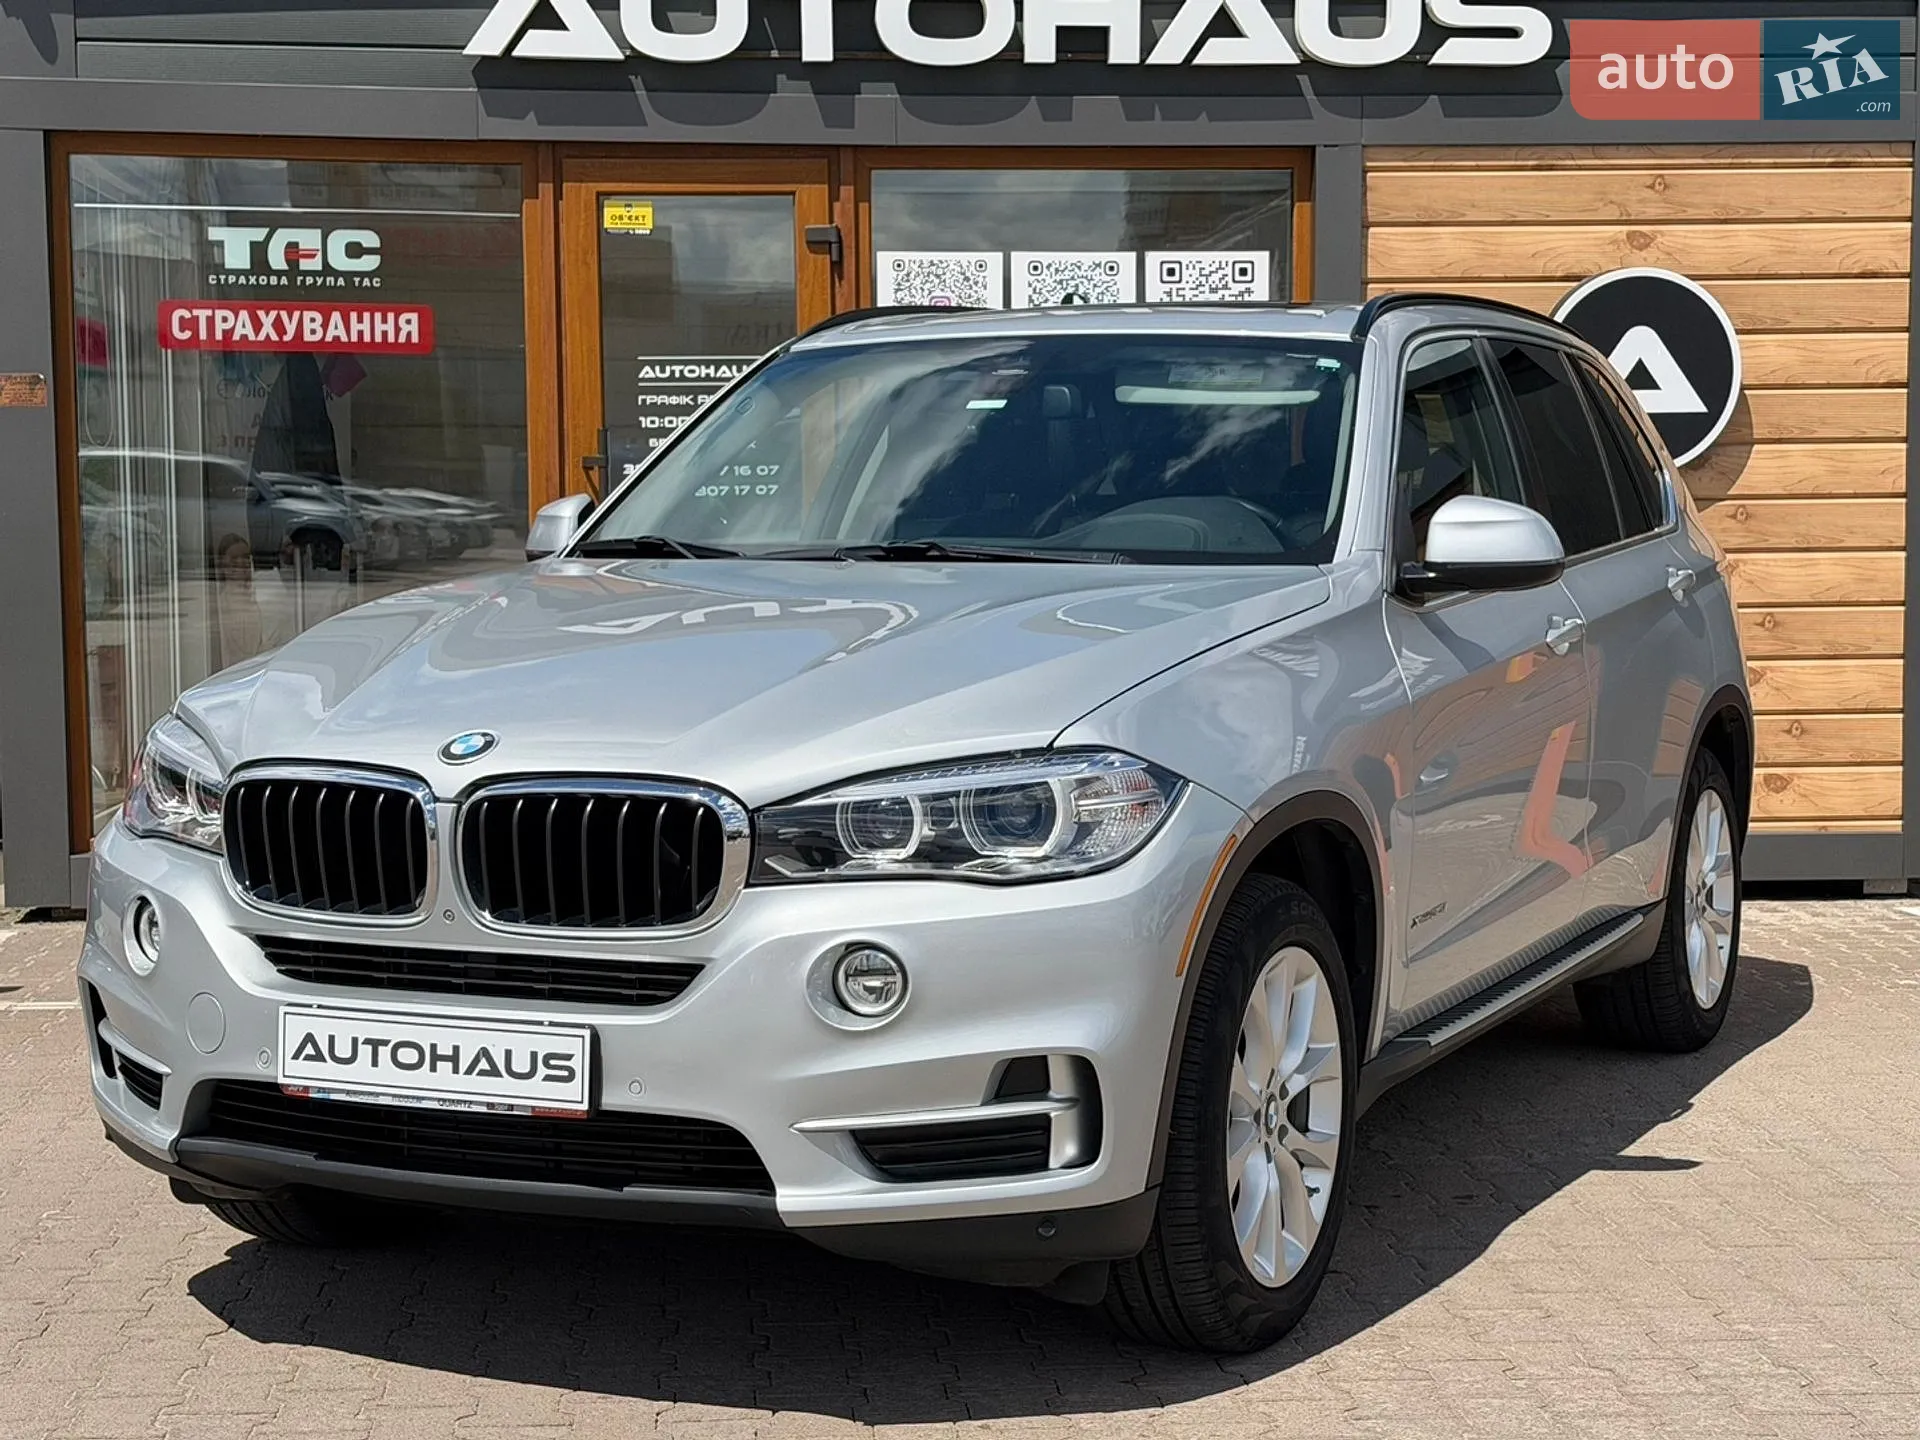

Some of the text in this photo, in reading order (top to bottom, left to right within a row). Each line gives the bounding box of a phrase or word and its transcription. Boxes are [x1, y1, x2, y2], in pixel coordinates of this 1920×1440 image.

[208, 274, 382, 288] СТРАХОВА ГРУПА ТАС
[171, 307, 420, 344] СТРАХУВАННЯ
[637, 364, 749, 379] AUTOHAU
[637, 394, 695, 406] ГРАФІК
[733, 464, 752, 477] 16
[756, 464, 780, 476] 07
[734, 484, 750, 496] 17
[755, 484, 779, 496] 07
[290, 1031, 577, 1084] AUTOHAUS
